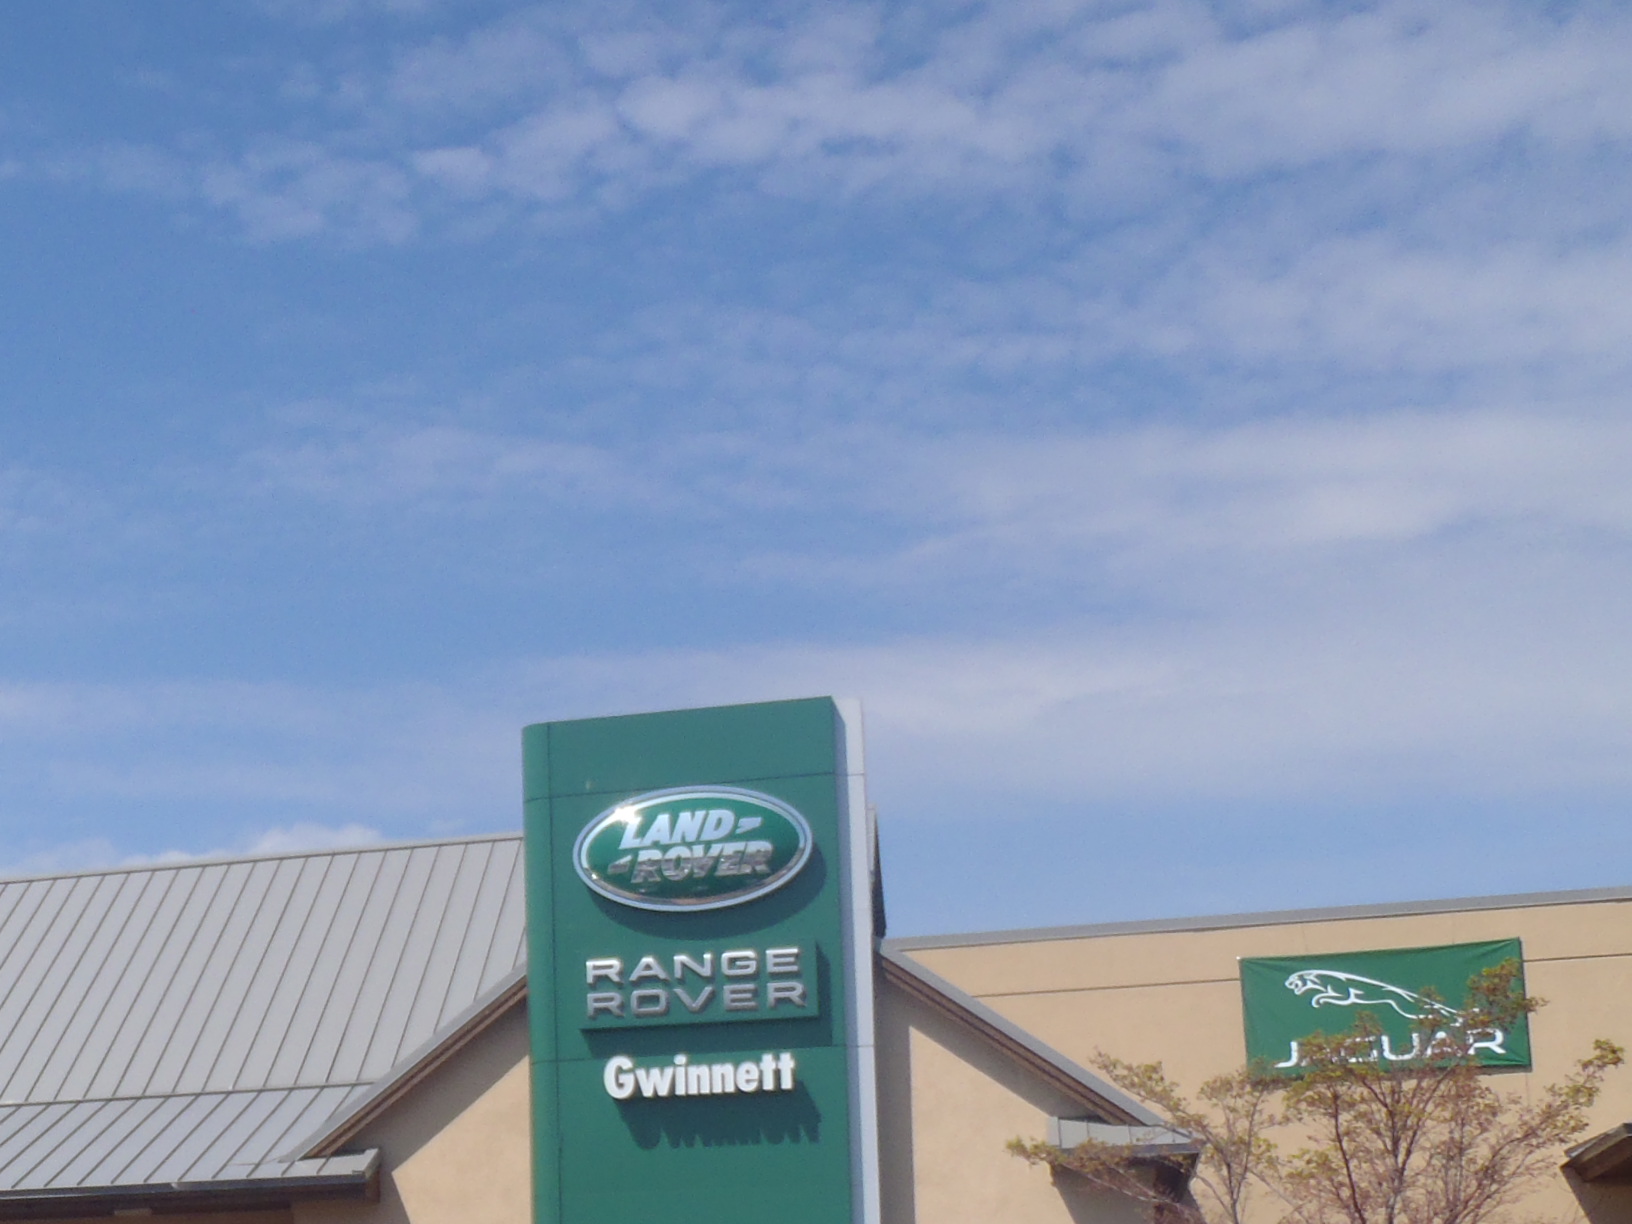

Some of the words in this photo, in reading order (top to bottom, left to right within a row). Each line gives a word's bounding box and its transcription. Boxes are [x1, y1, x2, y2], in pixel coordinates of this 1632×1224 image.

[618, 809, 735, 849] LAND
[630, 840, 773, 883] ROVER
[585, 948, 800, 984] RANGE
[586, 981, 808, 1017] ROVER
[603, 1052, 795, 1099] Gwinnett
